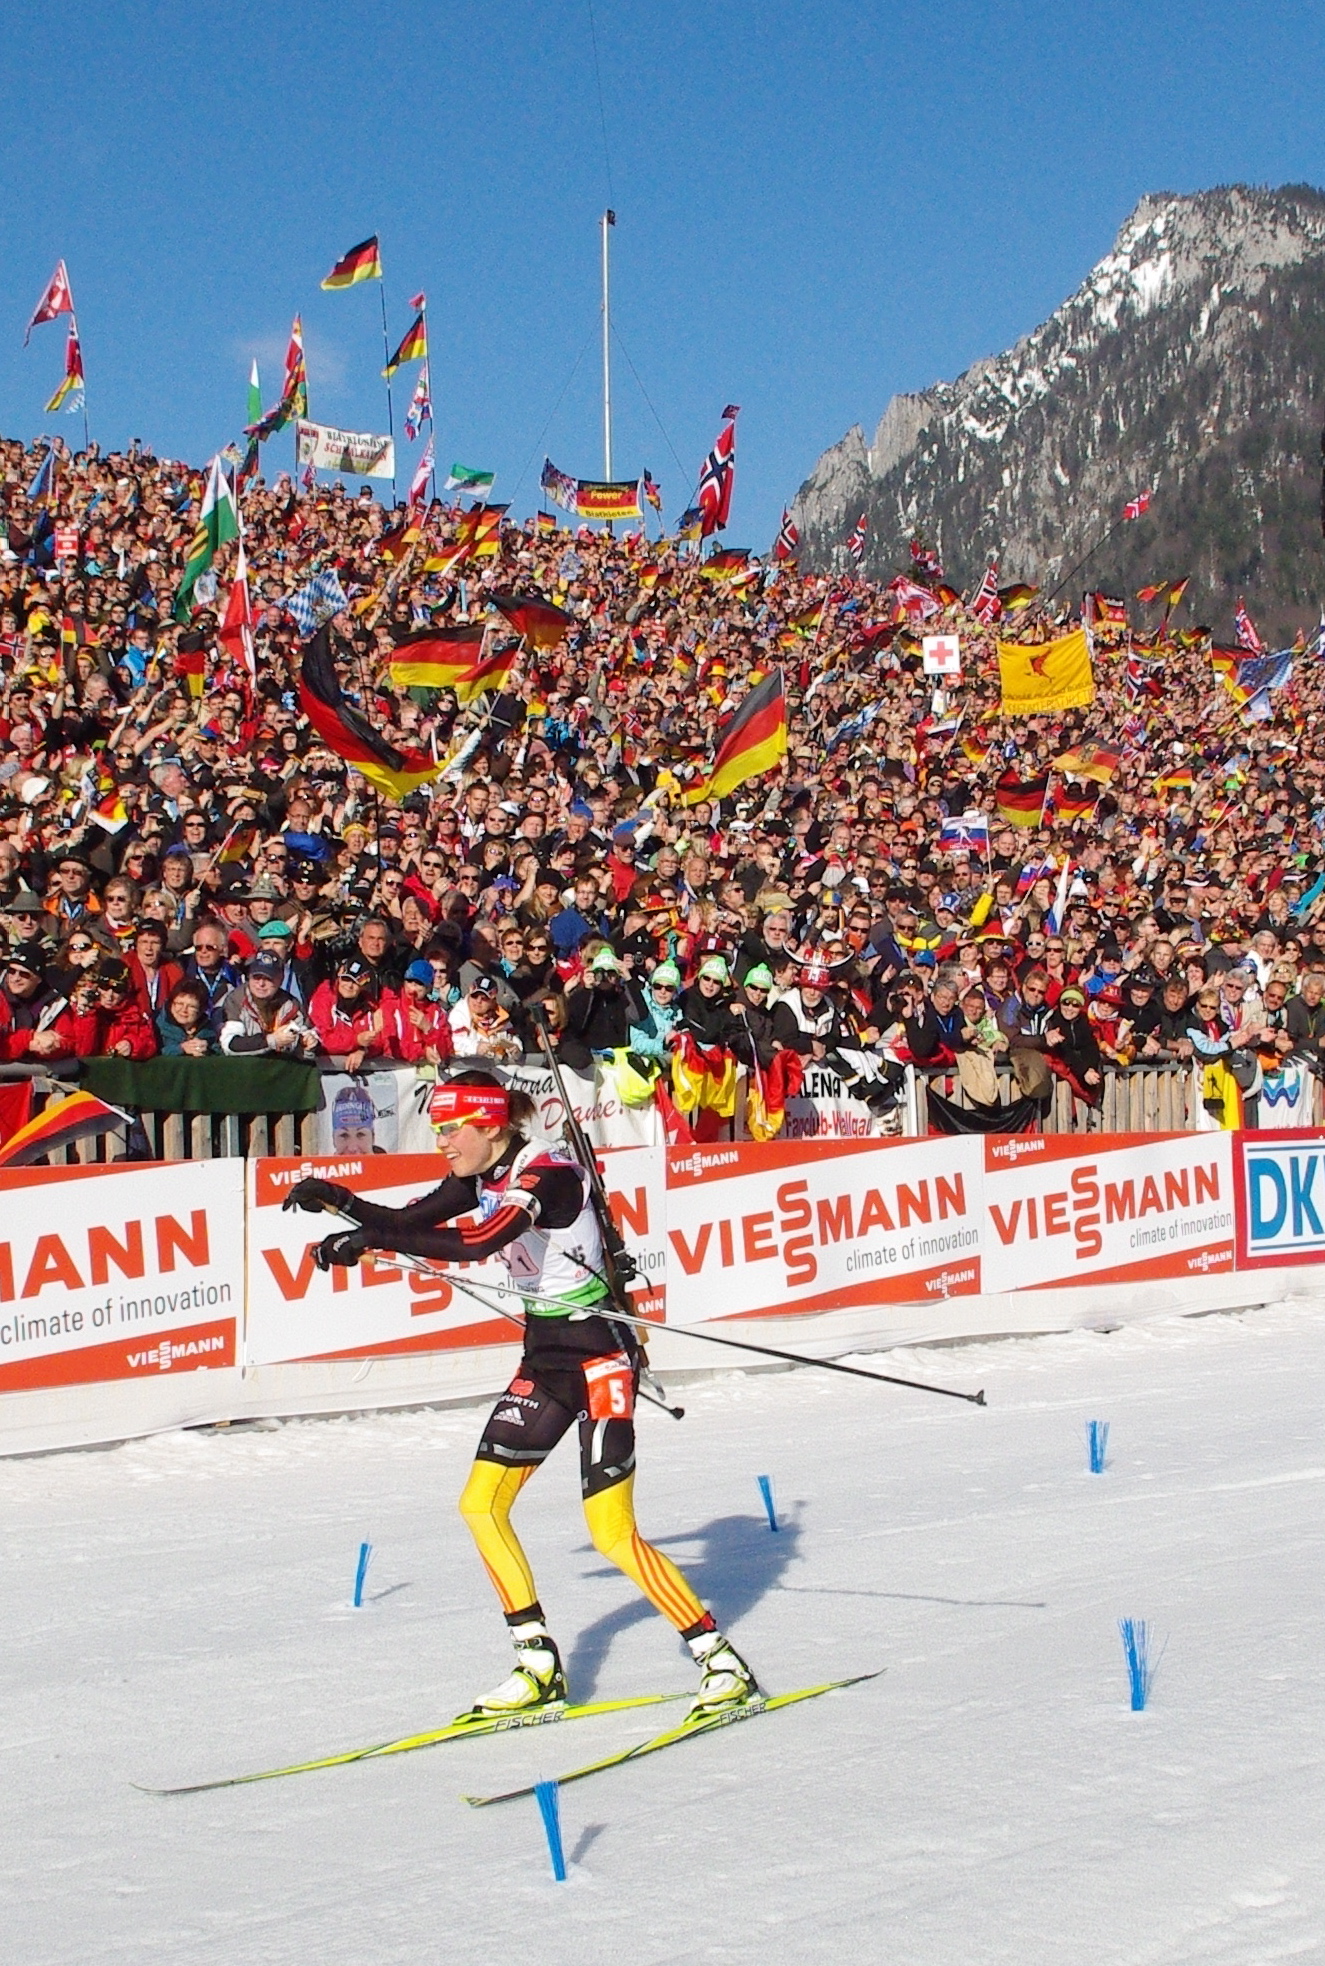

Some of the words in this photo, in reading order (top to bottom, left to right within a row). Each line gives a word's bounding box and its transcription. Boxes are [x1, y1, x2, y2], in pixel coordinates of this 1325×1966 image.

[671, 1150, 739, 1177] VIESSMANN
[992, 1139, 1045, 1161] VIESSMANN
[989, 1163, 1220, 1260] VIESSMANN
[1247, 1155, 1325, 1240] DK
[667, 1172, 966, 1288] VIESSMANN
[1130, 1226, 1166, 1248] climate
[1169, 1221, 1179, 1239] of
[1182, 1210, 1232, 1236] innovation
[846, 1243, 897, 1272] climate
[902, 1240, 915, 1261] of
[918, 1226, 979, 1254] innovation
[1187, 1250, 1233, 1272] VIESSMANN
[926, 1269, 975, 1299] VIESSMANN
[0, 1306, 84, 1345] climate
[92, 1296, 114, 1328] of
[119, 1282, 232, 1323] innovation
[126, 1335, 225, 1371] VIESSMANN
[608, 1379, 626, 1414] 5
[493, 1709, 565, 1732] FISCHER
[720, 1701, 767, 1725] FISCHER
